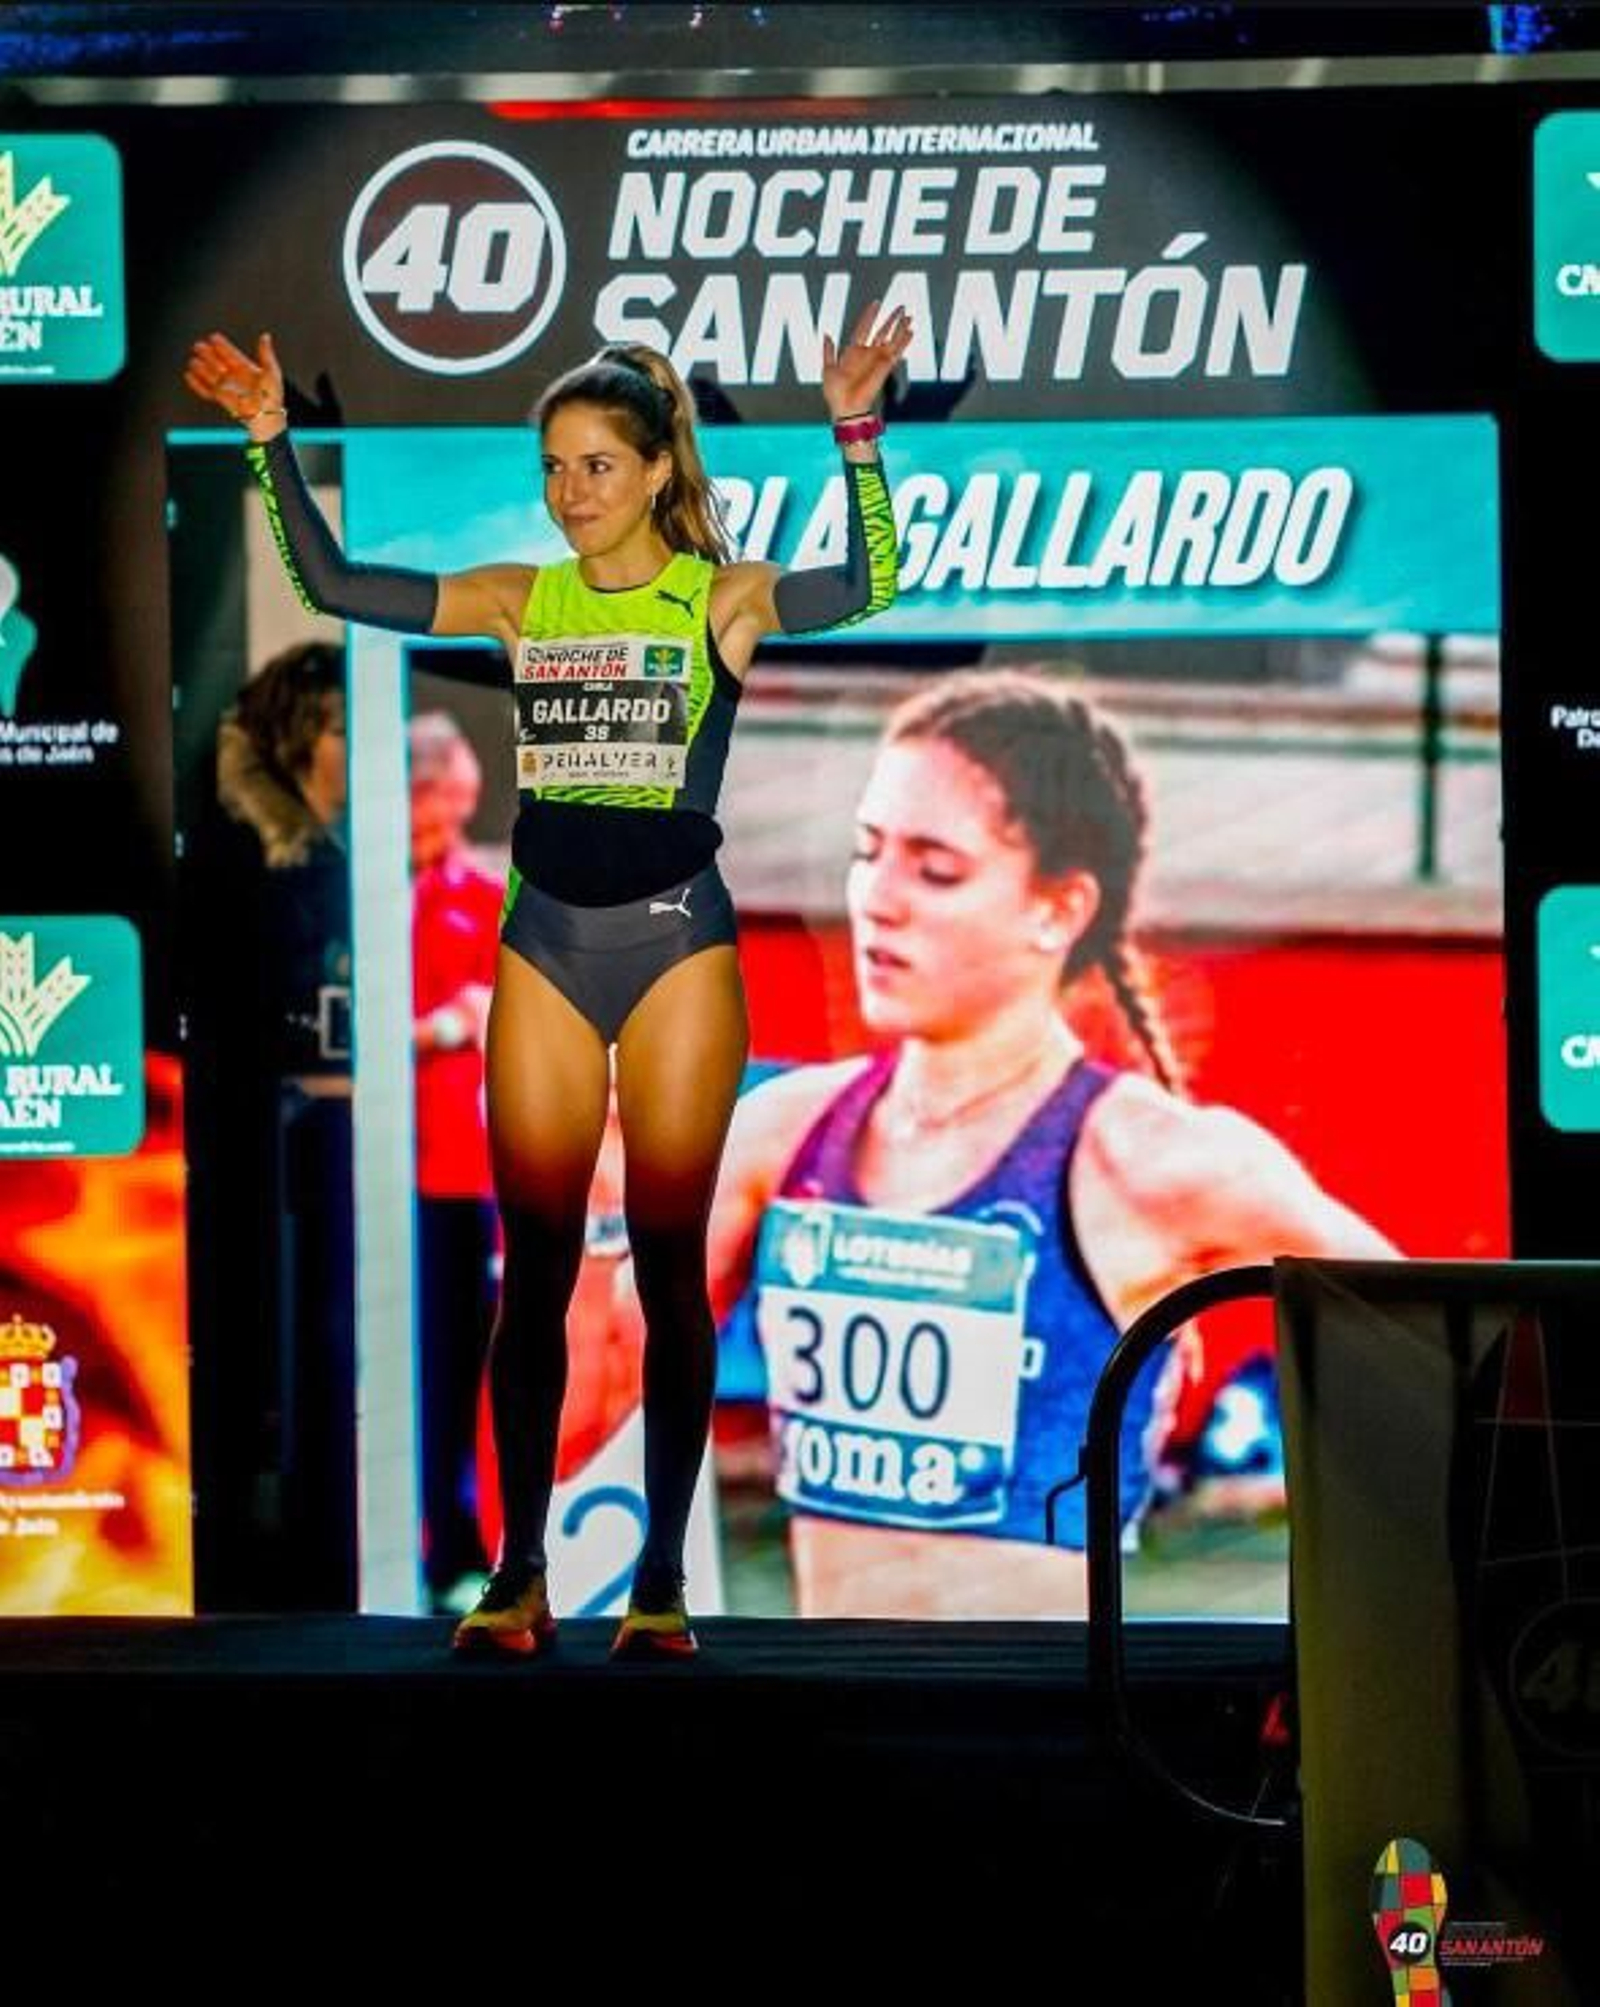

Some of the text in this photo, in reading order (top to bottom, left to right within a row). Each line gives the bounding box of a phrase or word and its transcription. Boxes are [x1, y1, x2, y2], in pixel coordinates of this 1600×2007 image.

[627, 123, 1099, 159] CARRERA URBANA INTERNACIONAL
[362, 203, 546, 313] 40
[607, 164, 1106, 260] NOCHE DE
[593, 233, 1307, 385] SAN ANTÓN
[897, 466, 1354, 591] GALLARDO
[524, 663, 562, 681] SAN
[532, 697, 672, 725] GALLARDO
[5, 1063, 123, 1096] RURAL
[788, 1306, 951, 1420] 300
